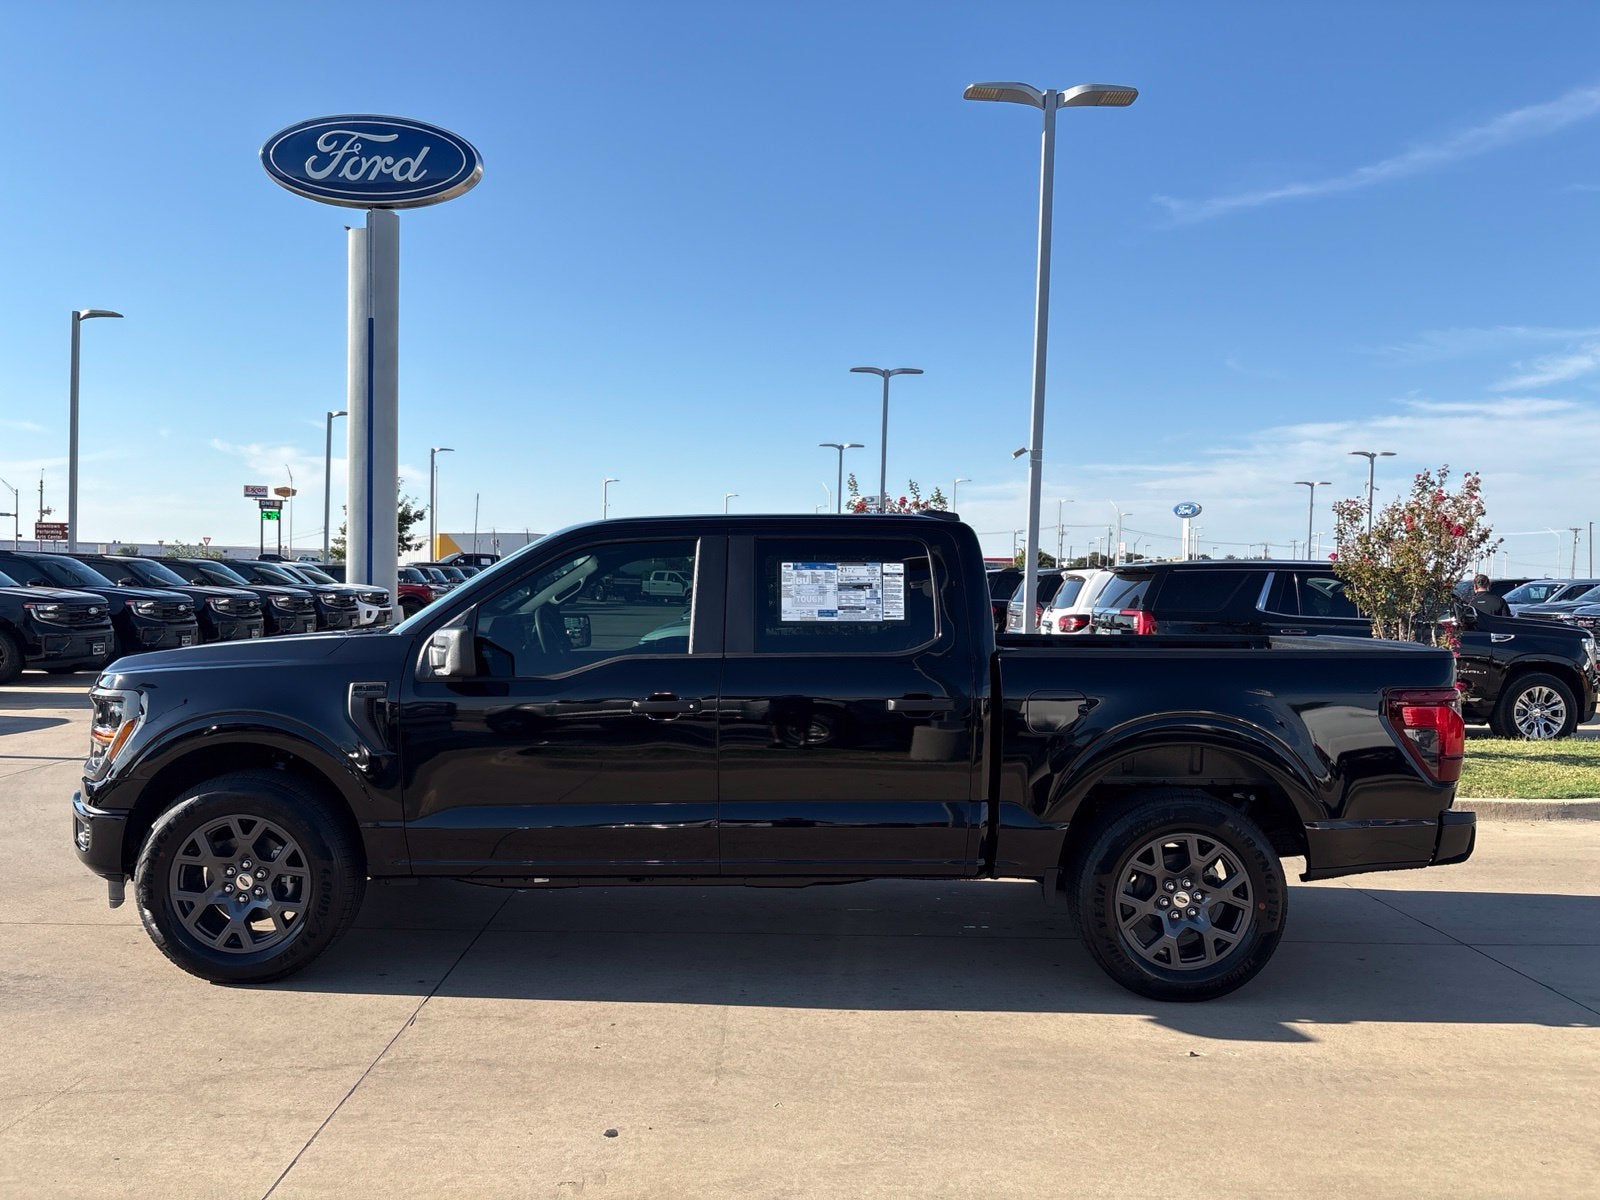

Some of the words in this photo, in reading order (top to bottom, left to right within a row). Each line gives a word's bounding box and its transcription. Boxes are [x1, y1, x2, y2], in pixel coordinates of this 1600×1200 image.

[305, 130, 431, 183] Ford
[246, 486, 267, 495] Exxon
[1177, 505, 1193, 515] Ford
